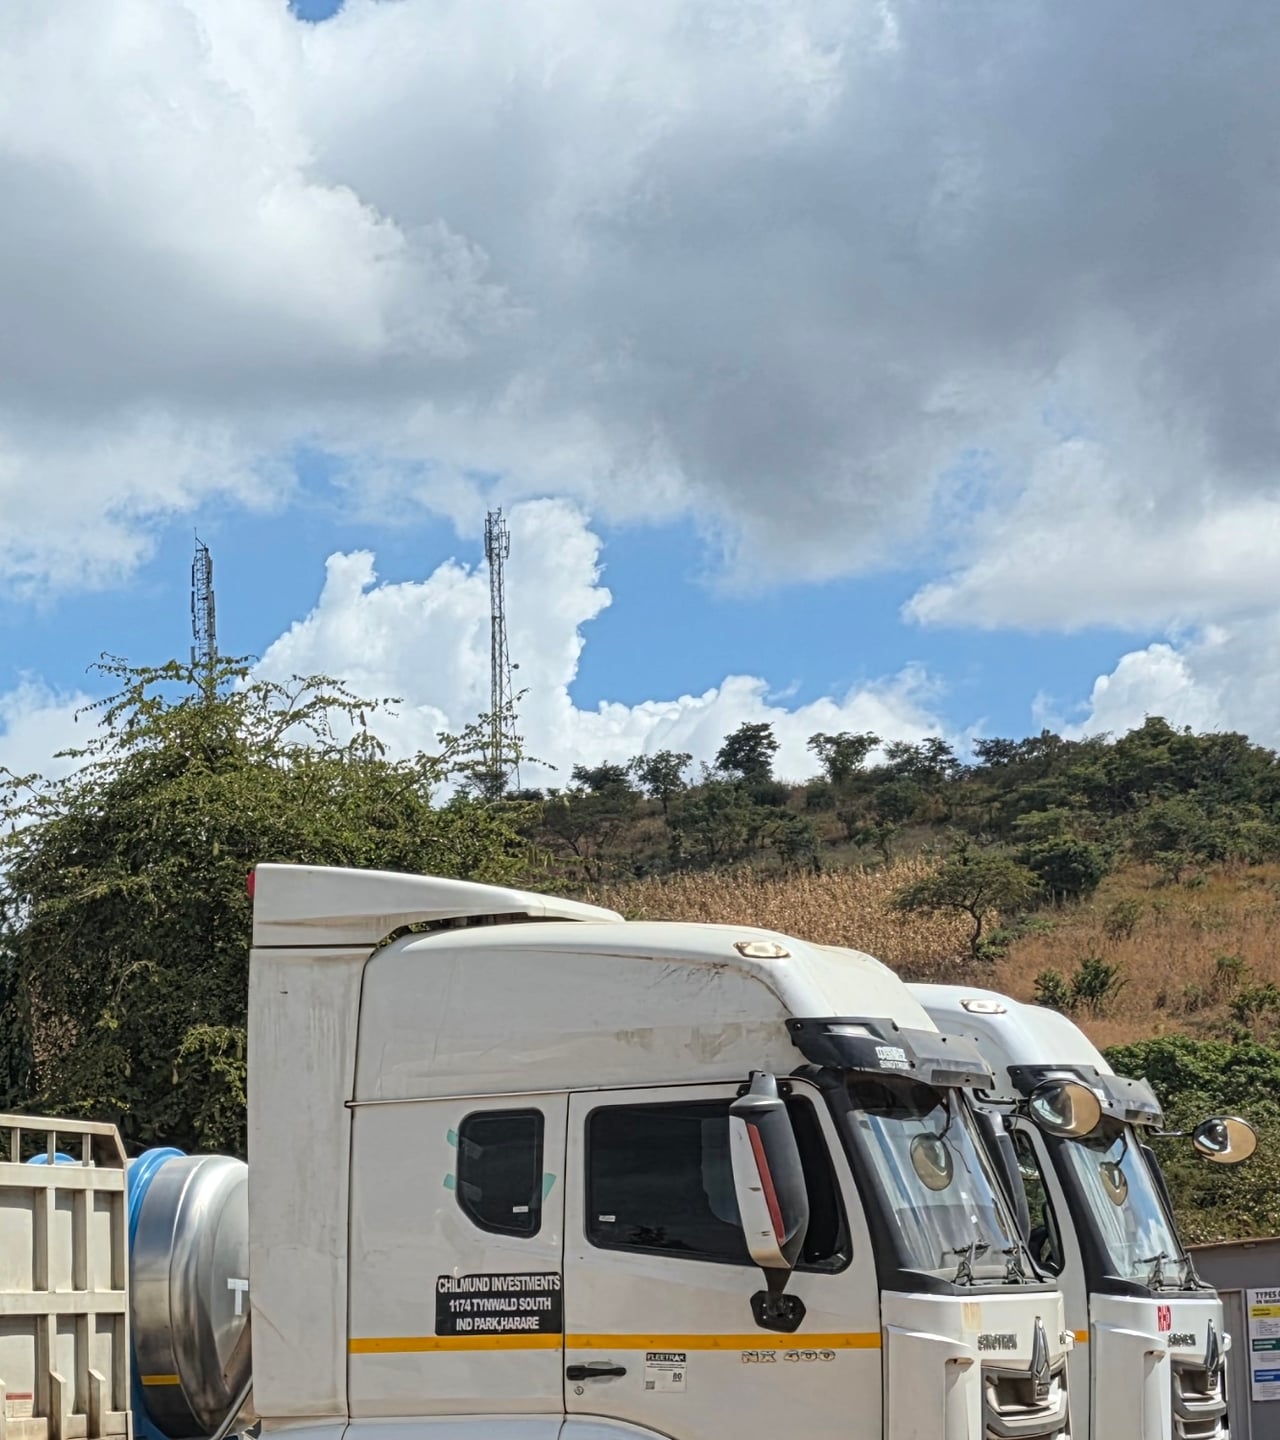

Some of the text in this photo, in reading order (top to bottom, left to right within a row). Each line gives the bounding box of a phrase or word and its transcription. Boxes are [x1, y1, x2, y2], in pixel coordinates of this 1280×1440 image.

[438, 1275, 561, 1293] CHILMUND INVESTMENTS
[1255, 1291, 1277, 1299] TYPES
[449, 1297, 552, 1312] 1174 TYNWALD SOUTH
[456, 1317, 473, 1331] IND
[784, 1349, 836, 1362] 400
